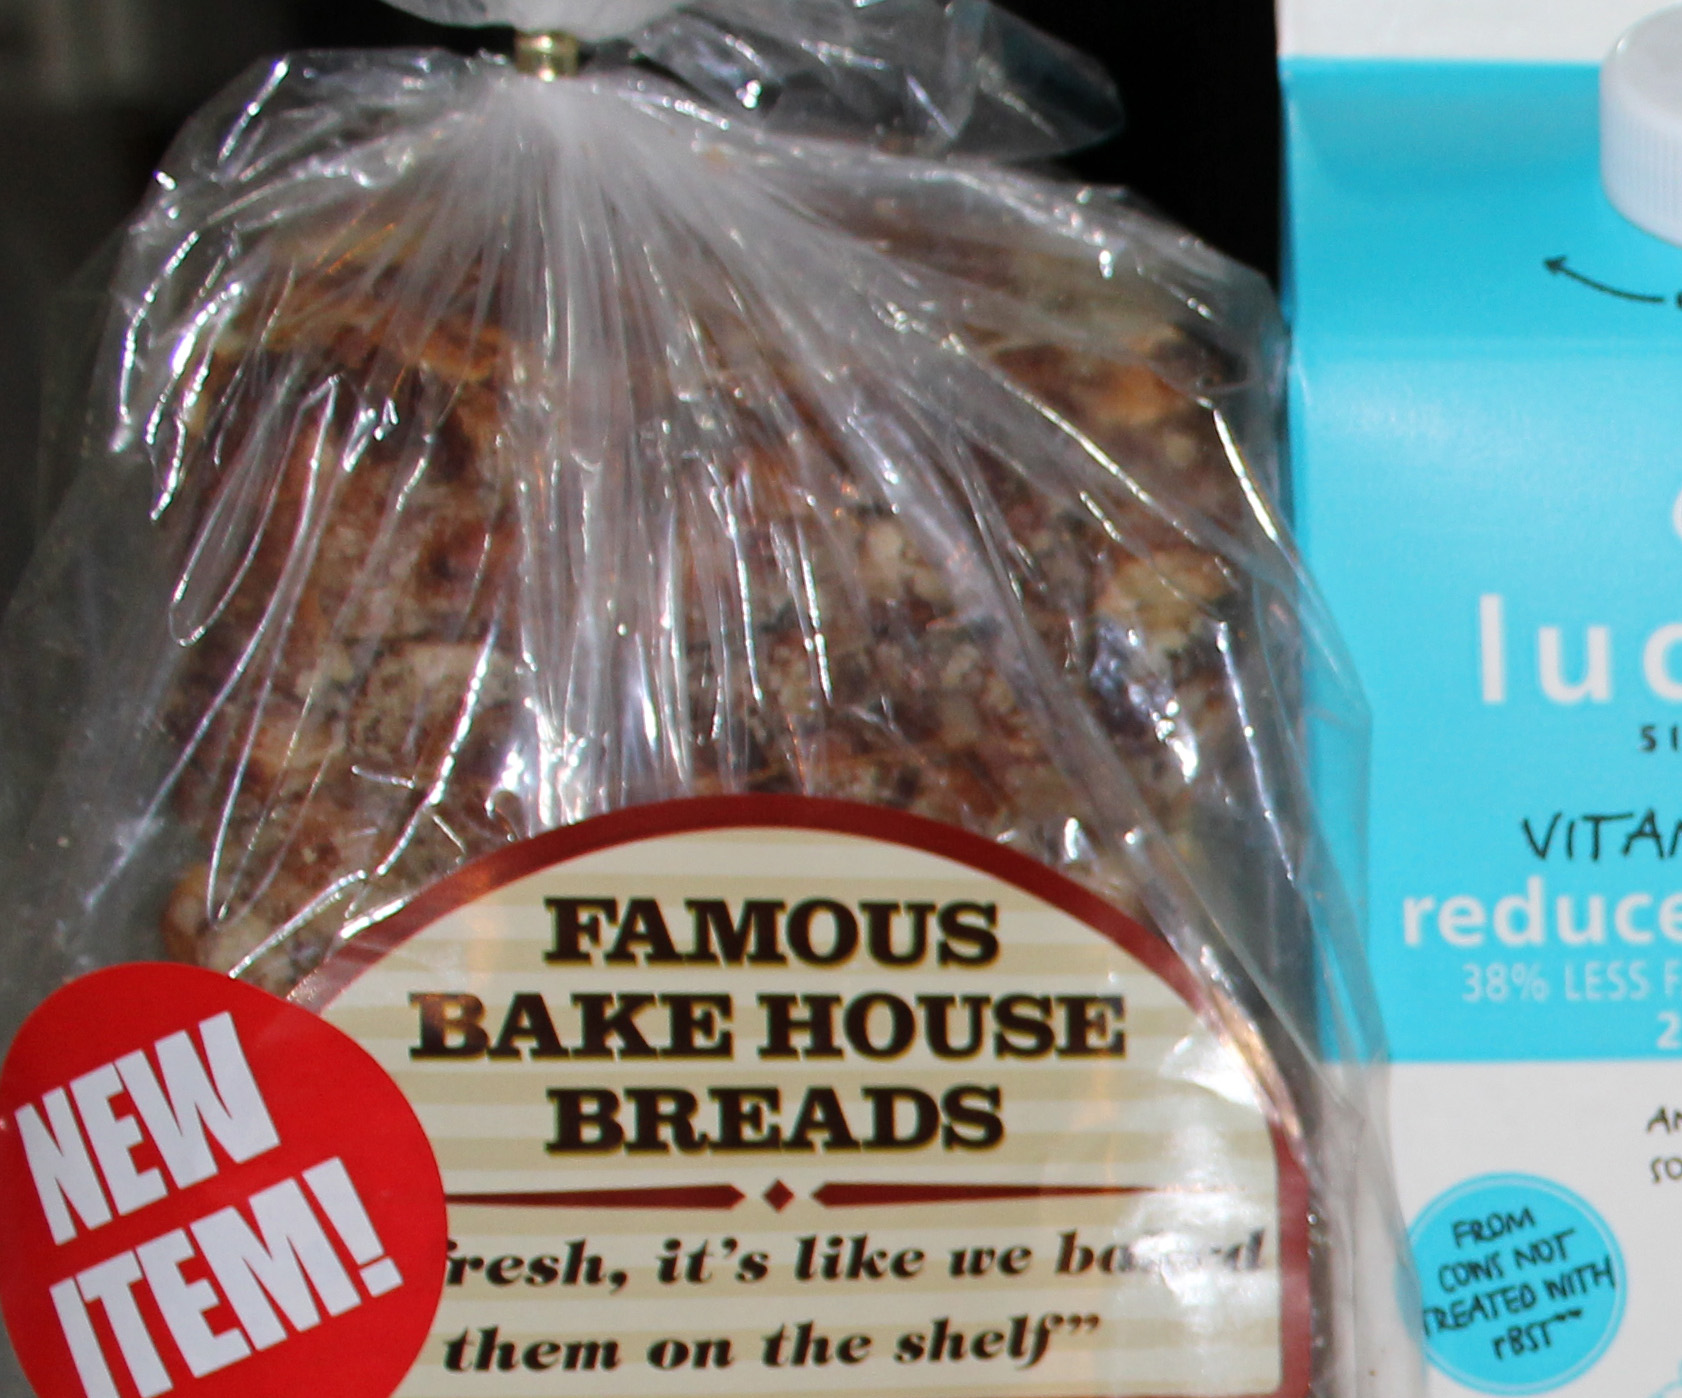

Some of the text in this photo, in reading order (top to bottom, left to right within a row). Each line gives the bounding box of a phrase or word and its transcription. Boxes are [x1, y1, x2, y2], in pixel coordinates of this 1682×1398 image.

[543, 895, 999, 968] FAMOUS
[1461, 962, 1551, 1003] 38%
[1563, 961, 1653, 1001] LESS
[409, 992, 1128, 1062] BAKE HOUSE
[14, 1009, 282, 1247] NEW
[543, 1084, 1005, 1156] BREADS
[655, 1236, 770, 1285] it's
[794, 1232, 926, 1282] like
[948, 1244, 1034, 1280] we
[1054, 1227, 1266, 1275] bad
[1452, 1205, 1537, 1250] FROM
[1512, 1227, 1577, 1270] NOT
[1419, 1282, 1537, 1339] TREATED
[443, 1324, 622, 1373] them
[645, 1337, 735, 1371] on
[759, 1319, 873, 1369] the
